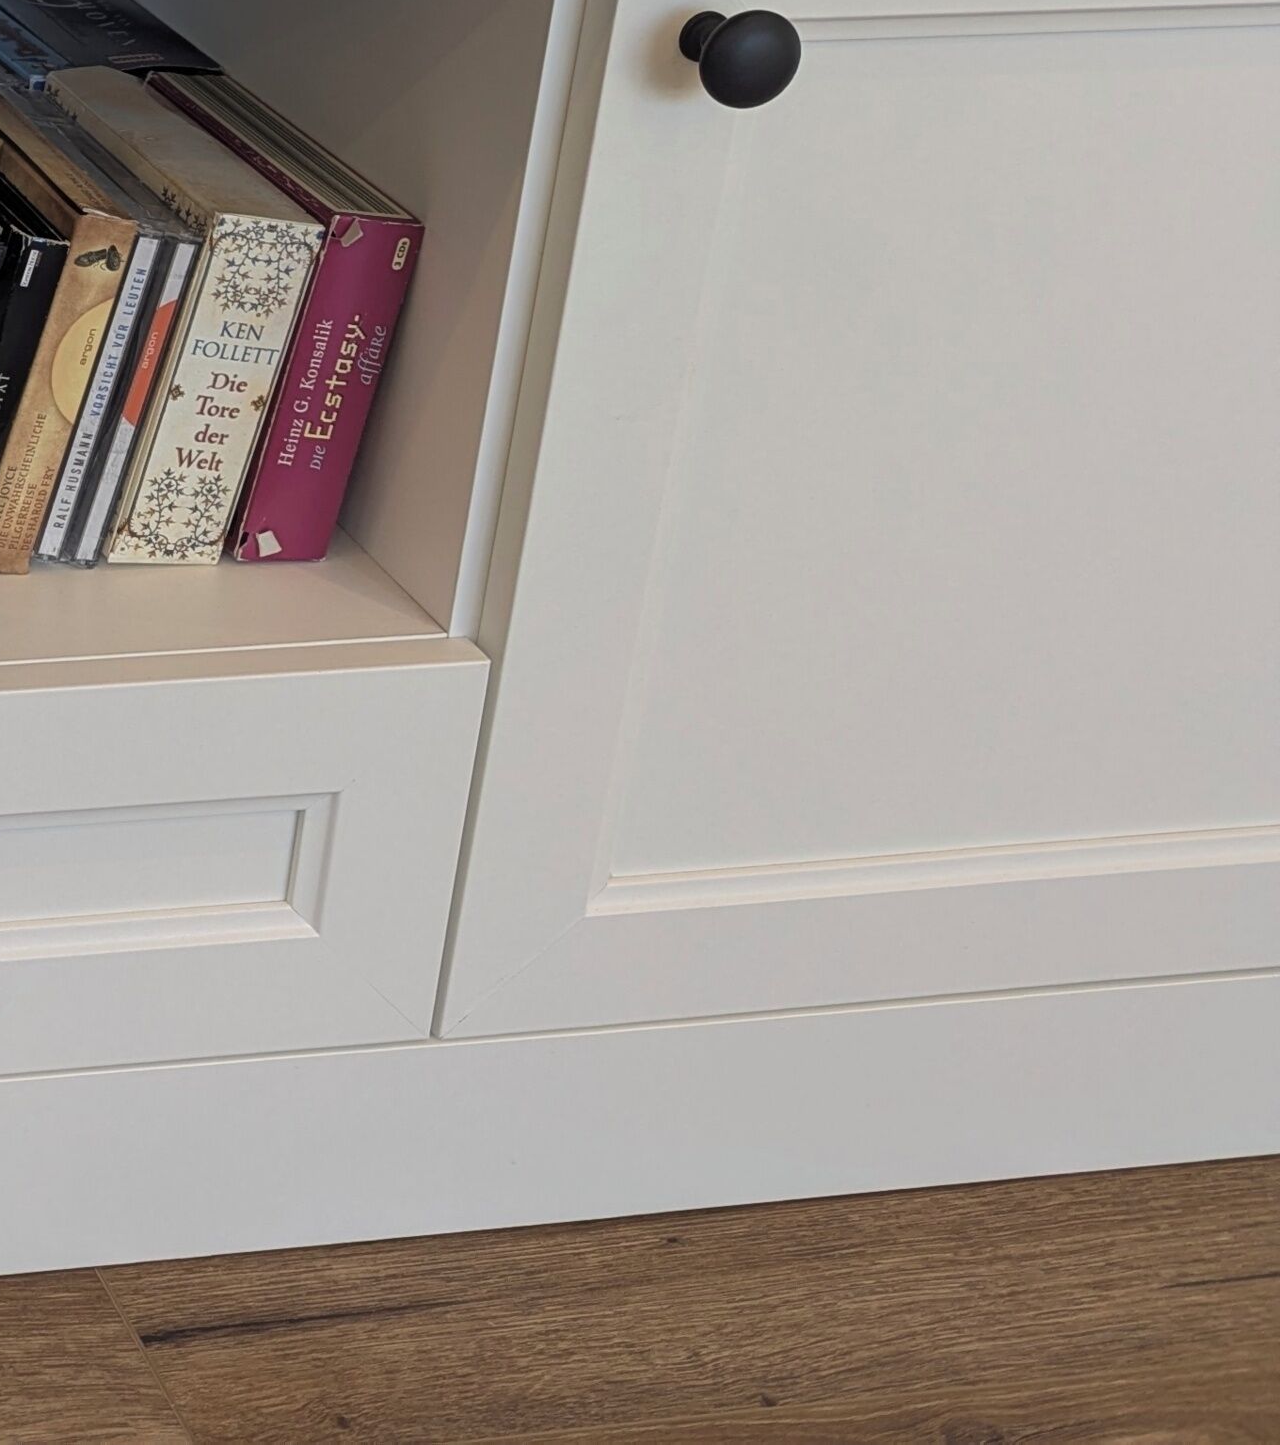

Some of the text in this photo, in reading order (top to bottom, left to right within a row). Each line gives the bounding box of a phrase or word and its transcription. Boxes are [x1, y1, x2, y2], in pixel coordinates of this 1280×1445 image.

[219, 320, 266, 342] KEN
[76, 325, 100, 367] argon
[191, 339, 280, 366] FOLLETT
[207, 371, 249, 393] Die
[276, 315, 334, 468] Heinz G. Konsalik
[52, 265, 147, 530] RALF HUSMANN VORSICHT VOR LEUTEN
[195, 395, 241, 419] Tore
[194, 424, 230, 445] der
[175, 446, 224, 473] Welt
[7, 480, 38, 551] PILGERREISE
[19, 464, 57, 552] DES HAROLD FRY
